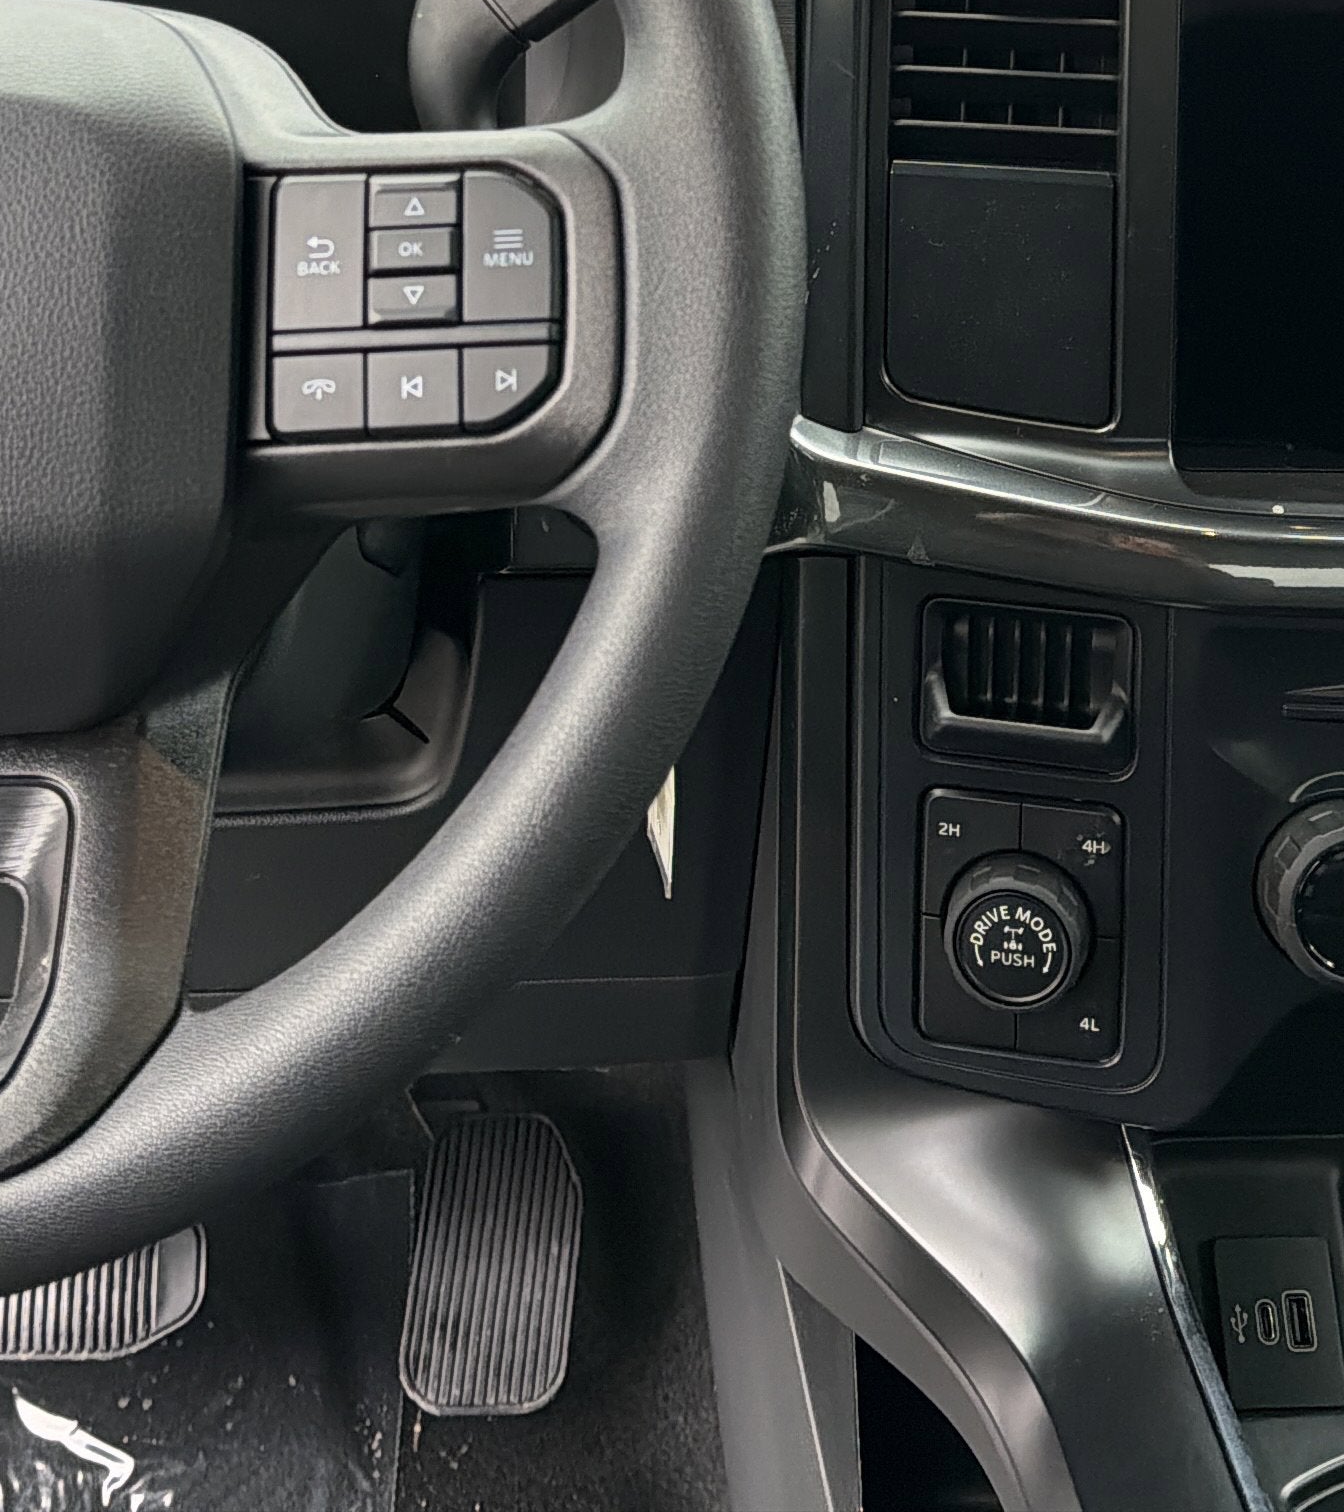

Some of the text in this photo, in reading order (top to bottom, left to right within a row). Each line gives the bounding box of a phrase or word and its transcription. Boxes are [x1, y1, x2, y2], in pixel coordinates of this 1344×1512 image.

[397, 241, 424, 257] OK
[482, 251, 534, 267] MENU
[296, 260, 341, 277] BACK
[937, 822, 961, 838] 2H
[1081, 839, 1105, 855] 4H
[969, 905, 1057, 954] DRIVE MODE
[990, 951, 1036, 969] PUSH
[1079, 1017, 1101, 1032] 4L
